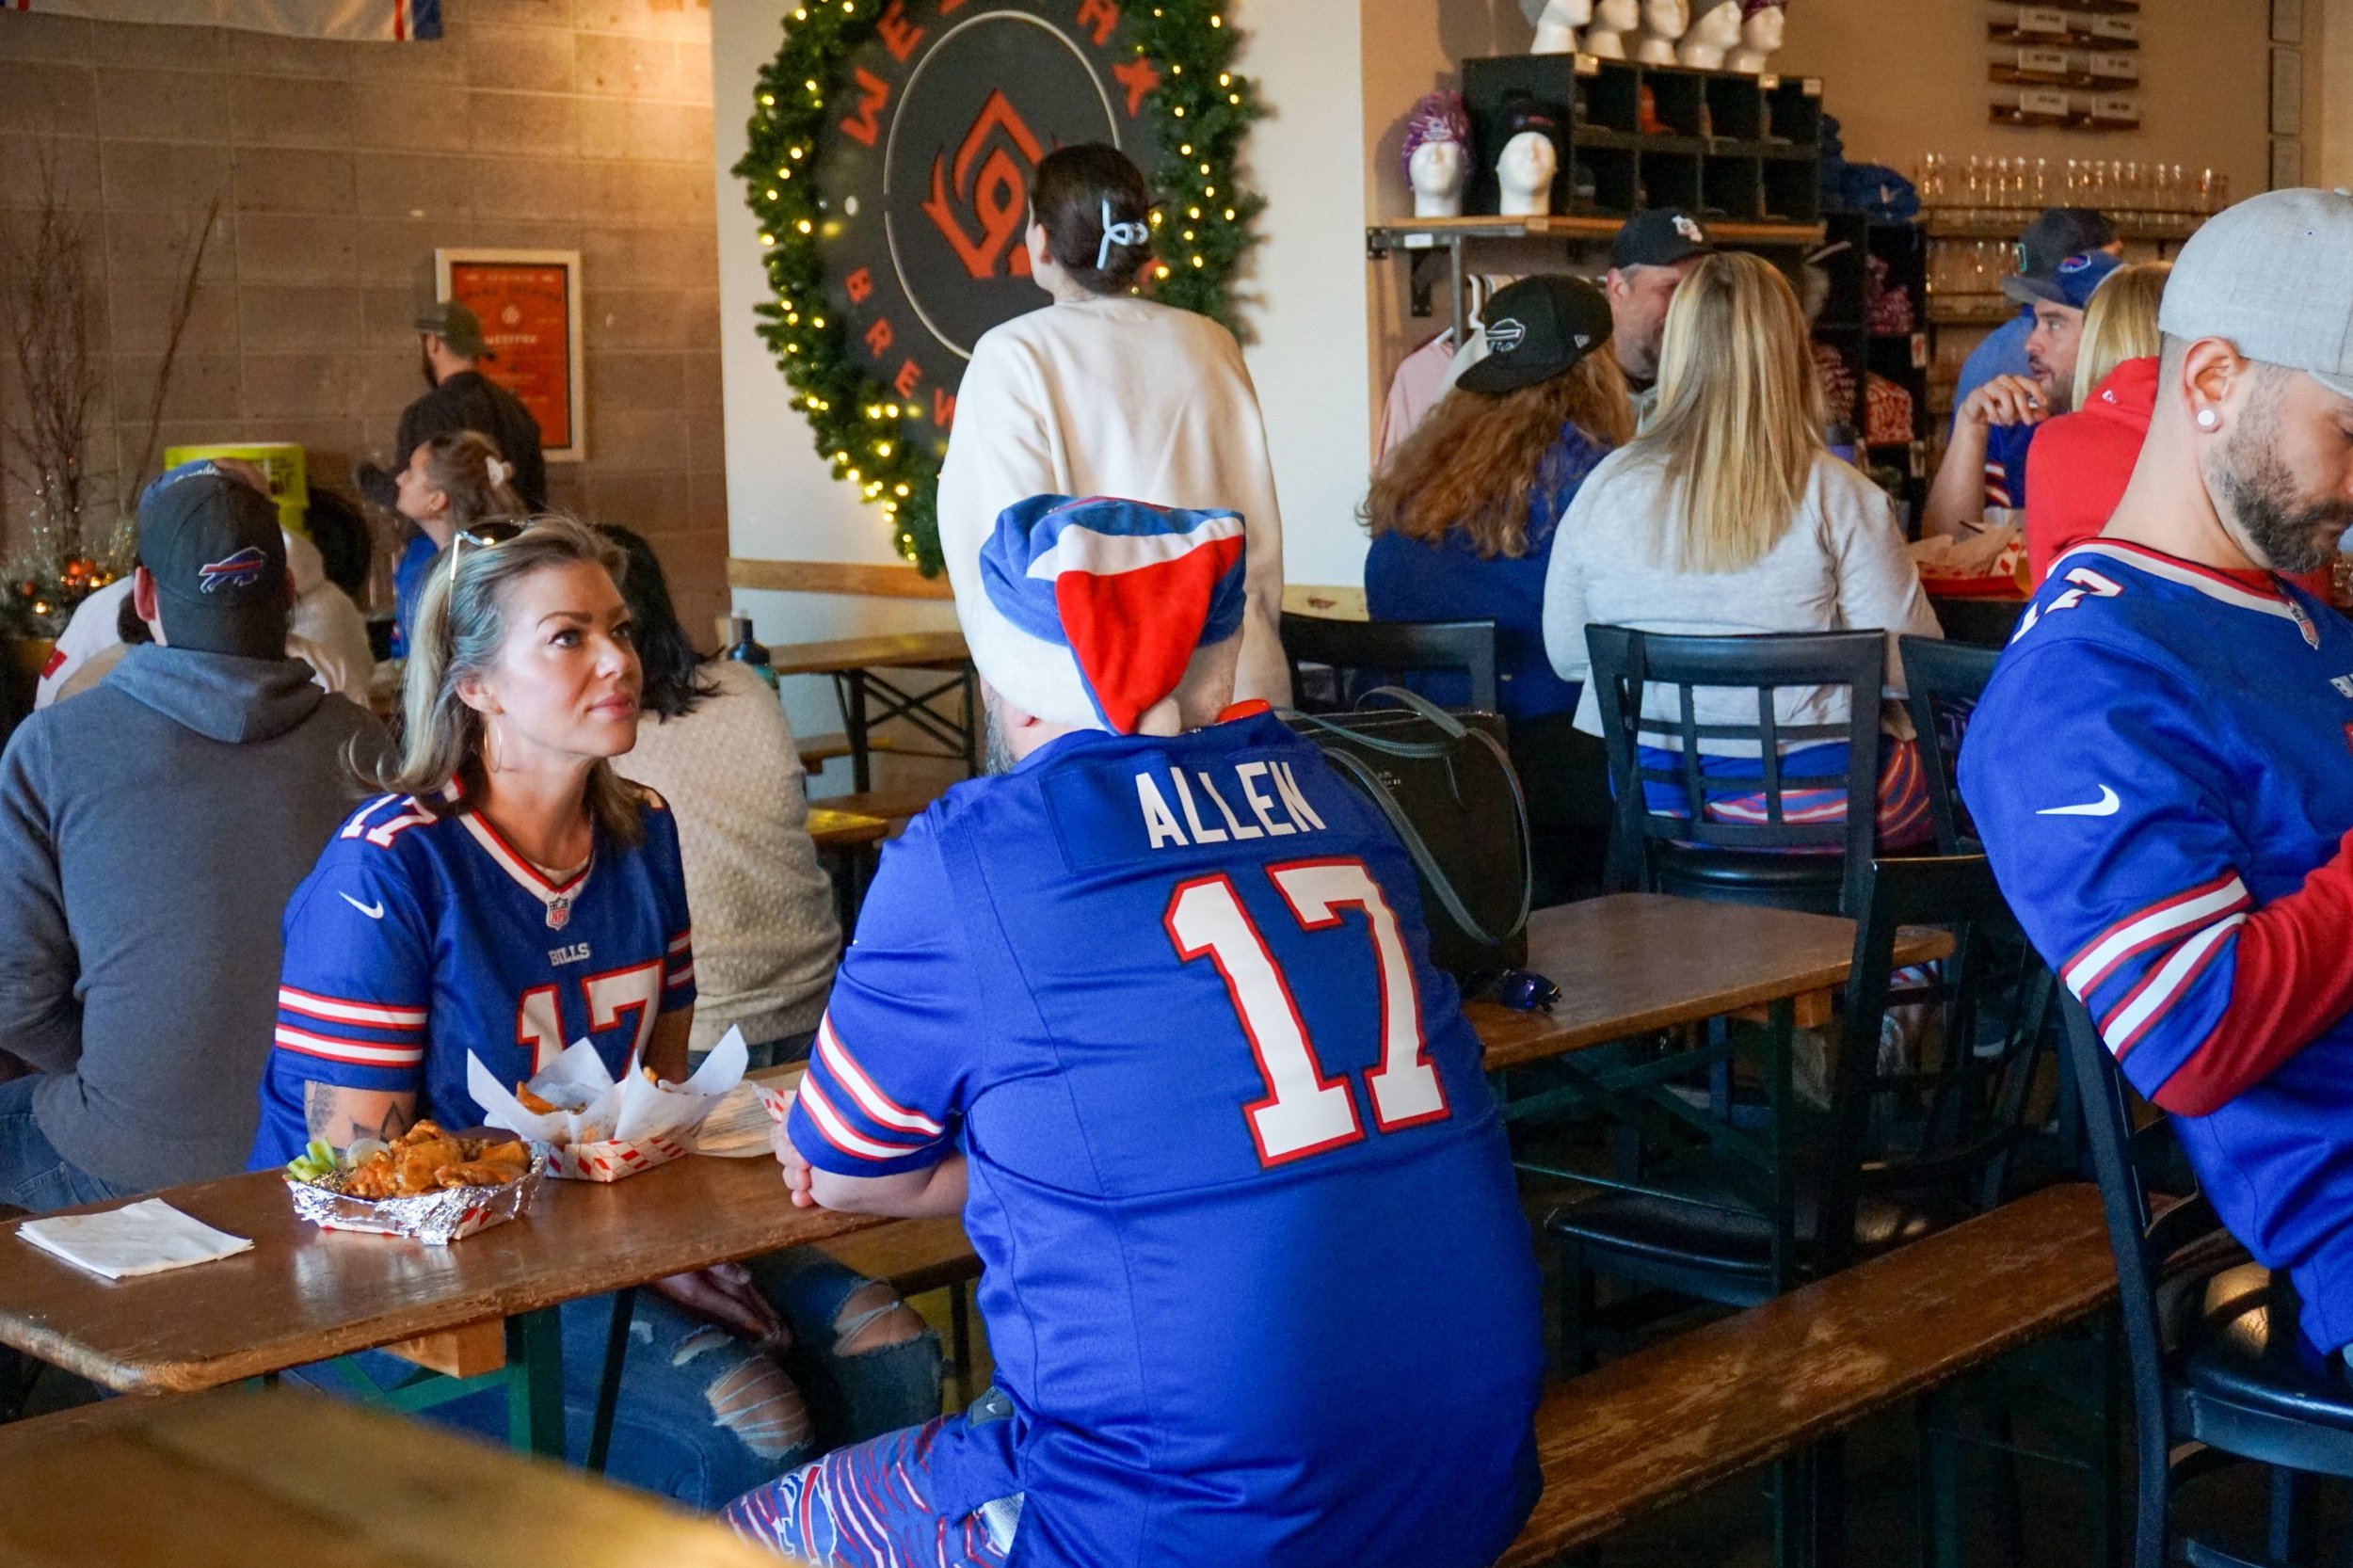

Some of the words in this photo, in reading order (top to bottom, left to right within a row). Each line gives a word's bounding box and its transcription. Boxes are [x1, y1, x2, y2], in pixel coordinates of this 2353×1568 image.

[340, 792, 440, 851] 17
[1135, 760, 1327, 849] ALLEN
[548, 942, 591, 967] BILLS
[516, 957, 664, 1082] 17
[1161, 855, 1451, 1169] 17
